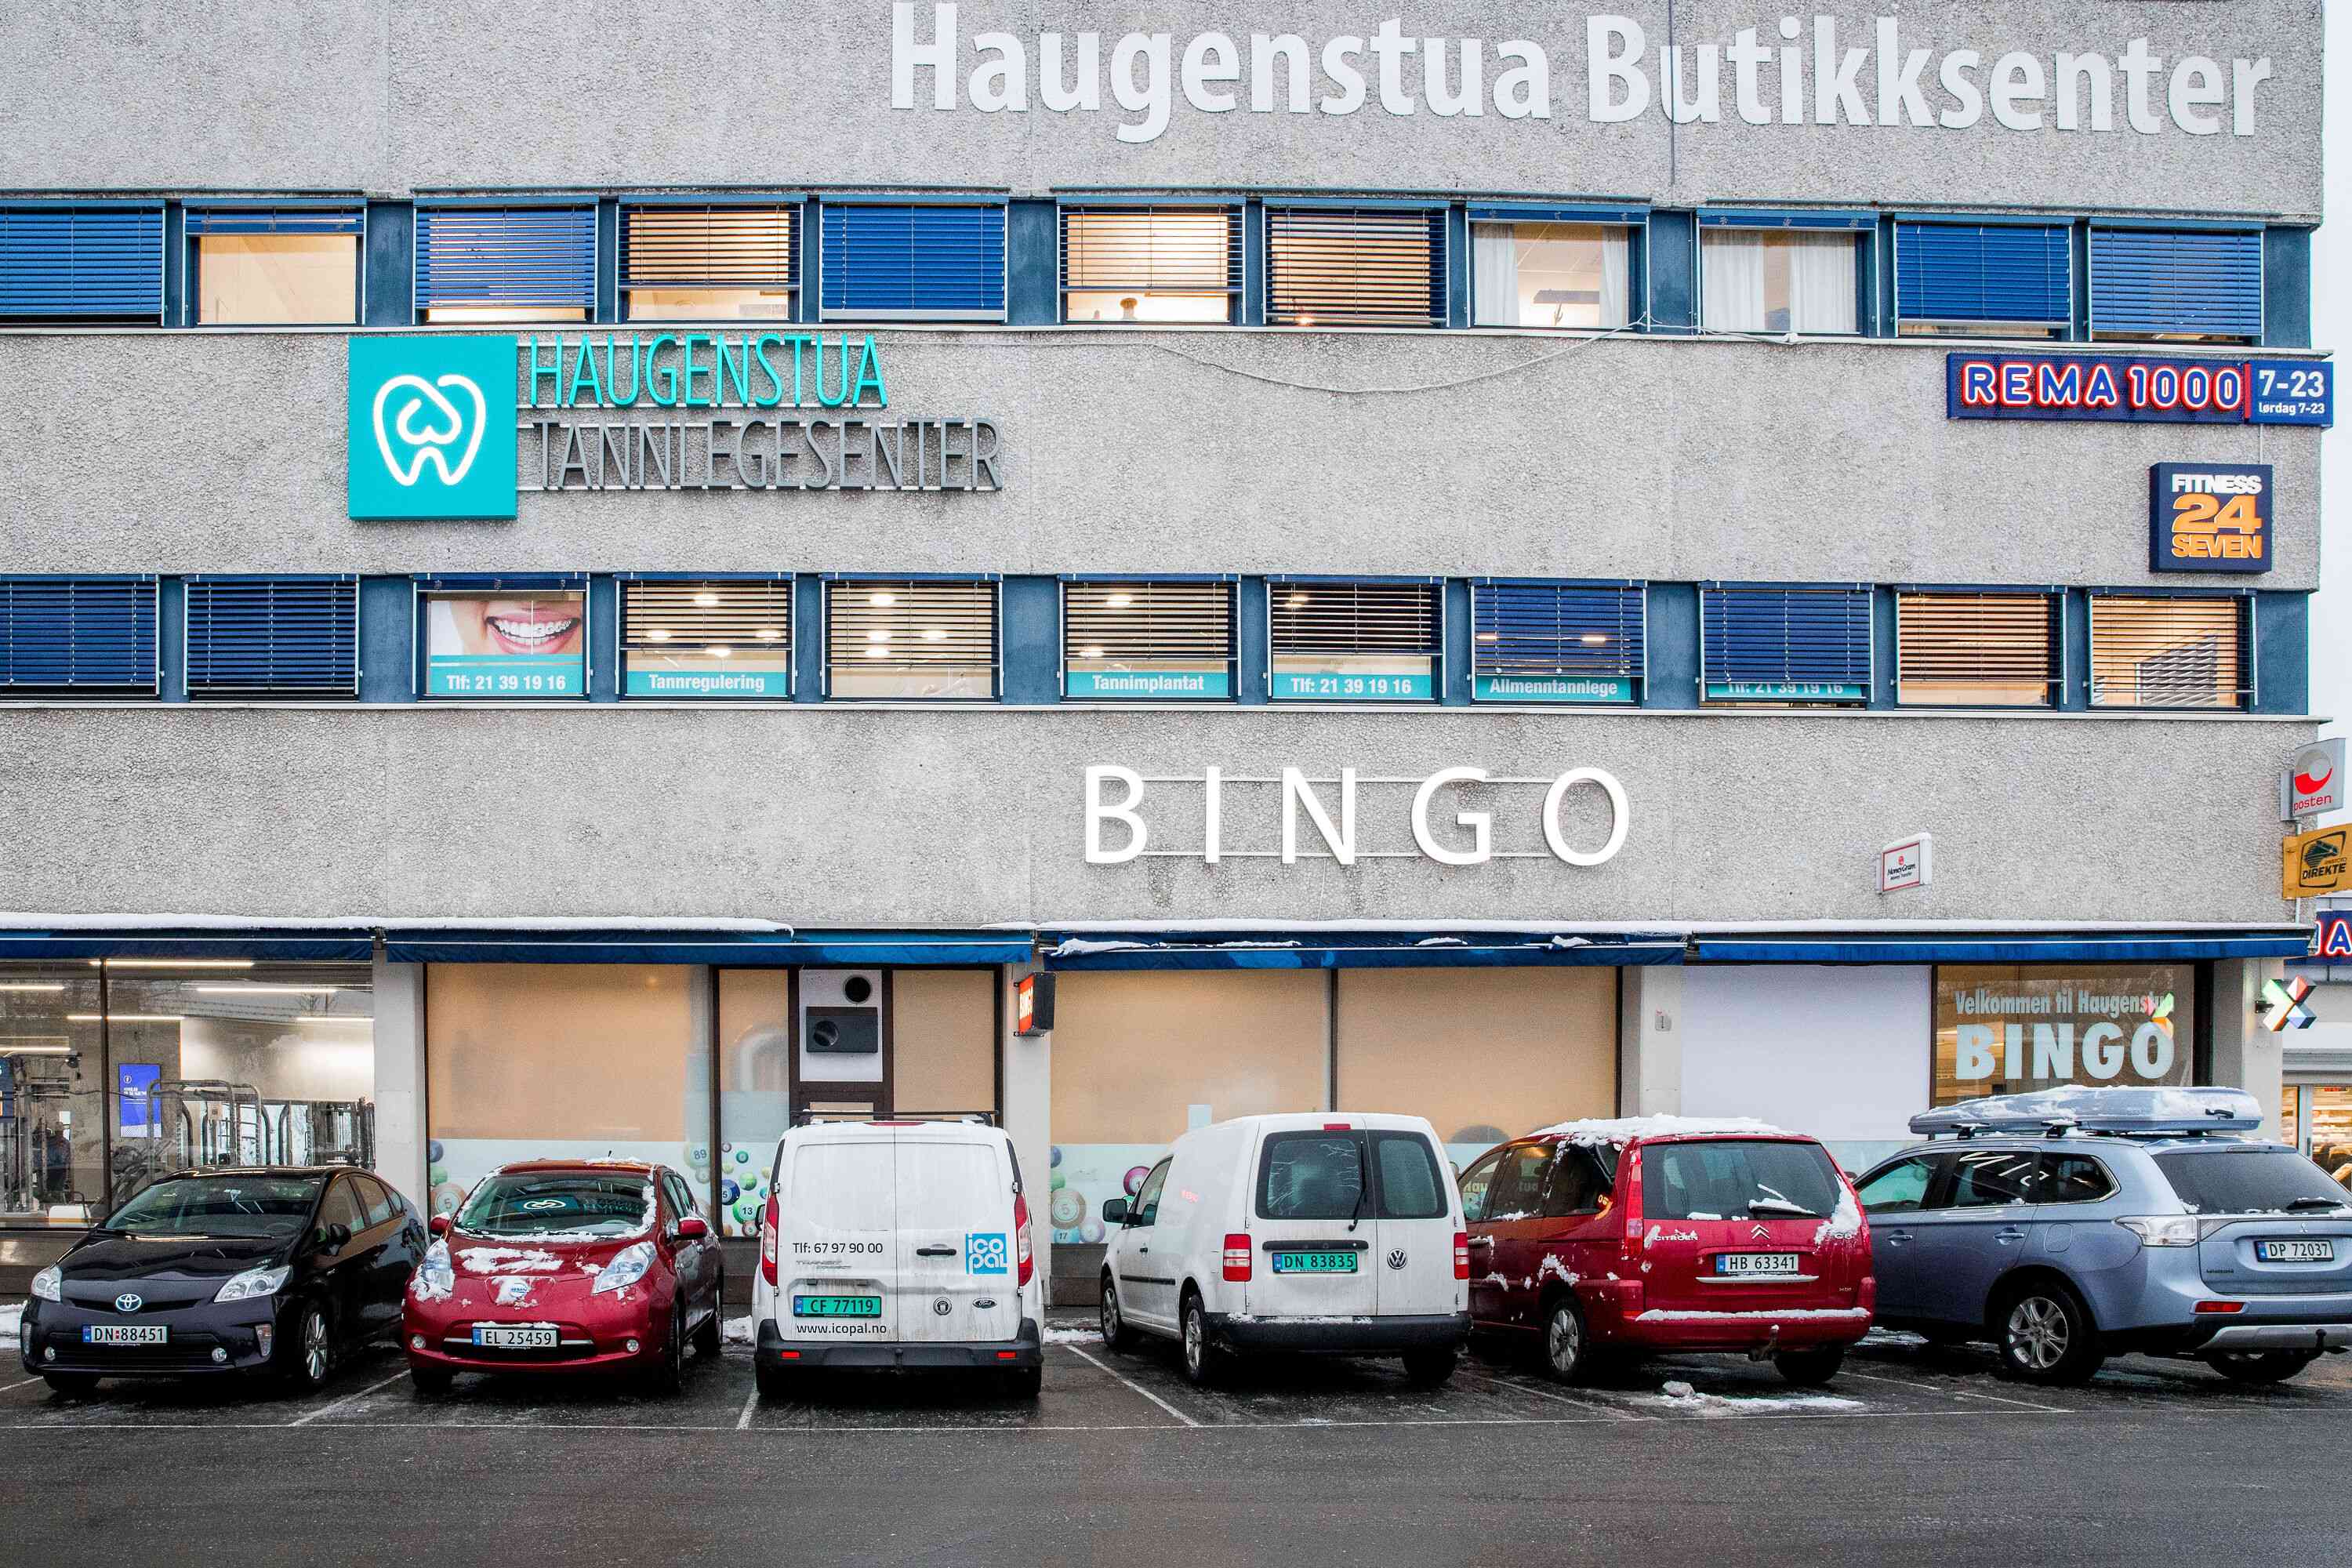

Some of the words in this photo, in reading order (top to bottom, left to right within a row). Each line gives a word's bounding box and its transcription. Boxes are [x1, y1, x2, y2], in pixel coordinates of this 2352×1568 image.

[891, 1, 1551, 144] Haugenstua
[1585, 15, 2272, 136] Butikksenter
[530, 333, 888, 408] HAUGENSTUA
[1962, 361, 2118, 408] REMA
[2128, 365, 2244, 412] 1000
[2258, 368, 2325, 397] 7-23
[2298, 402, 2325, 414] 7-23
[534, 416, 1004, 492] TANNLEGESENTER
[2171, 474, 2262, 494] FITNESS
[2171, 492, 2263, 535] 24
[2171, 534, 2263, 559] SEVEN
[446, 675, 469, 690] Tlf:
[474, 675, 493, 690] 21
[499, 675, 518, 690] 39
[524, 675, 542, 690] 19
[548, 675, 566, 690] 16
[648, 673, 765, 692] Tannregulering
[1092, 674, 1205, 695] Tannimplantat
[1290, 677, 1316, 694] Tlf:
[1320, 677, 1338, 694] 21
[1343, 677, 1363, 694] 39
[1368, 677, 1388, 694] 19
[1392, 677, 1412, 694] 16
[2294, 794, 2332, 815] posten
[1085, 764, 1630, 867] BINGO
[2301, 862, 2347, 880] DIREKTE
[1955, 990, 2051, 1014] Velkommen
[2055, 990, 2074, 1014] til
[1955, 1022, 2175, 1080] BINGO
[694, 1149, 707, 1160] 89
[742, 1207, 753, 1215] 13
[793, 1243, 811, 1254] Tlf:
[814, 1243, 829, 1254] 67
[831, 1243, 846, 1254] 97
[849, 1243, 865, 1254] 90
[868, 1243, 884, 1254] 00
[2269, 1243, 2286, 1256] DP
[2291, 1243, 2328, 1257] 72037
[1284, 1255, 1305, 1268] DN
[1310, 1255, 1354, 1269] 83835
[1730, 1257, 1748, 1269] HB
[1754, 1256, 1795, 1270] 63341
[810, 1299, 827, 1312] CF
[833, 1299, 873, 1313] 77119
[94, 1327, 114, 1341] DN
[121, 1327, 163, 1341] 88451
[485, 1331, 501, 1345] EL
[507, 1331, 552, 1345] 25459
[797, 1323, 887, 1337] www.icopal.no
